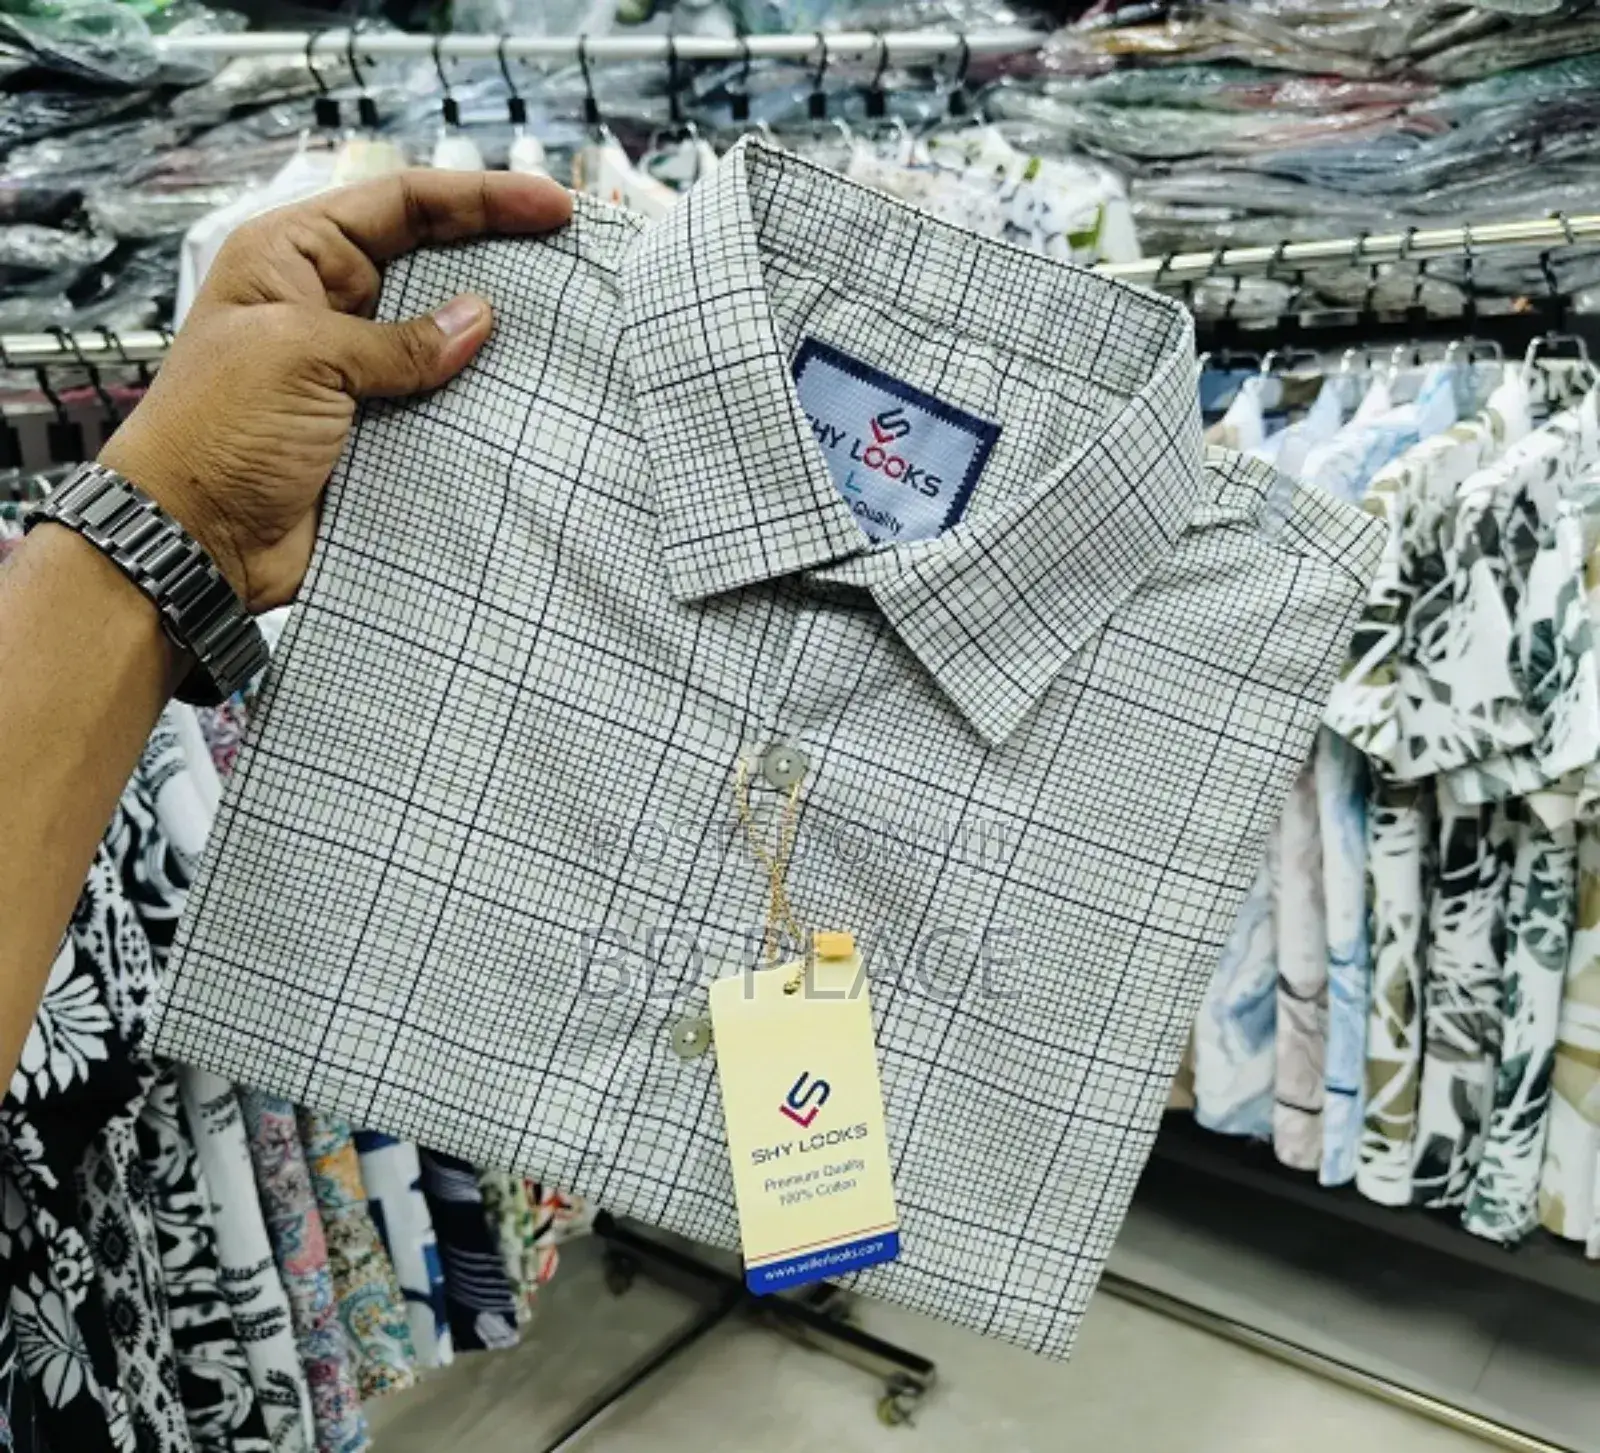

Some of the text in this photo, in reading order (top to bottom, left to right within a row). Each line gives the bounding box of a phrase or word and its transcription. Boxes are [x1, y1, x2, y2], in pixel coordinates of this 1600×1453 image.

[804, 412, 942, 498] HY LOOKS
[845, 470, 862, 494] L
[853, 501, 904, 536] Quality
[751, 1122, 869, 1166] SHY LOOKS
[822, 1159, 866, 1178] Quality
[815, 1178, 858, 1197] Cotton
